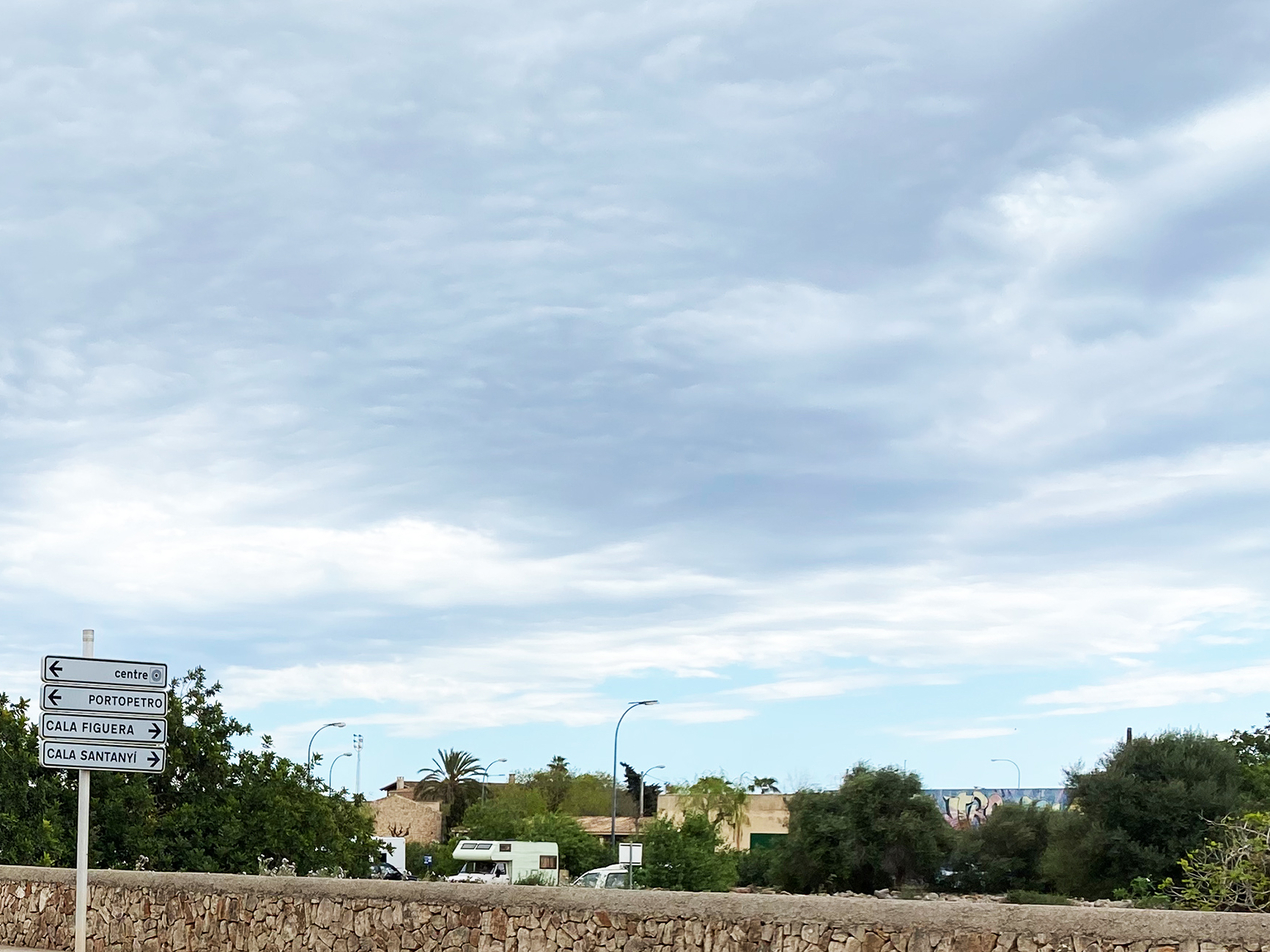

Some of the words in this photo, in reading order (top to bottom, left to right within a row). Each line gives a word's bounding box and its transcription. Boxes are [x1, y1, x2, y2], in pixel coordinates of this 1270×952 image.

[115, 669, 148, 680] centre
[88, 694, 163, 709] PORTOPETRO
[46, 720, 77, 732] CALA
[82, 722, 134, 735] FIGUERA
[47, 748, 76, 760] CALA
[80, 750, 137, 764] SANTANYÍ
